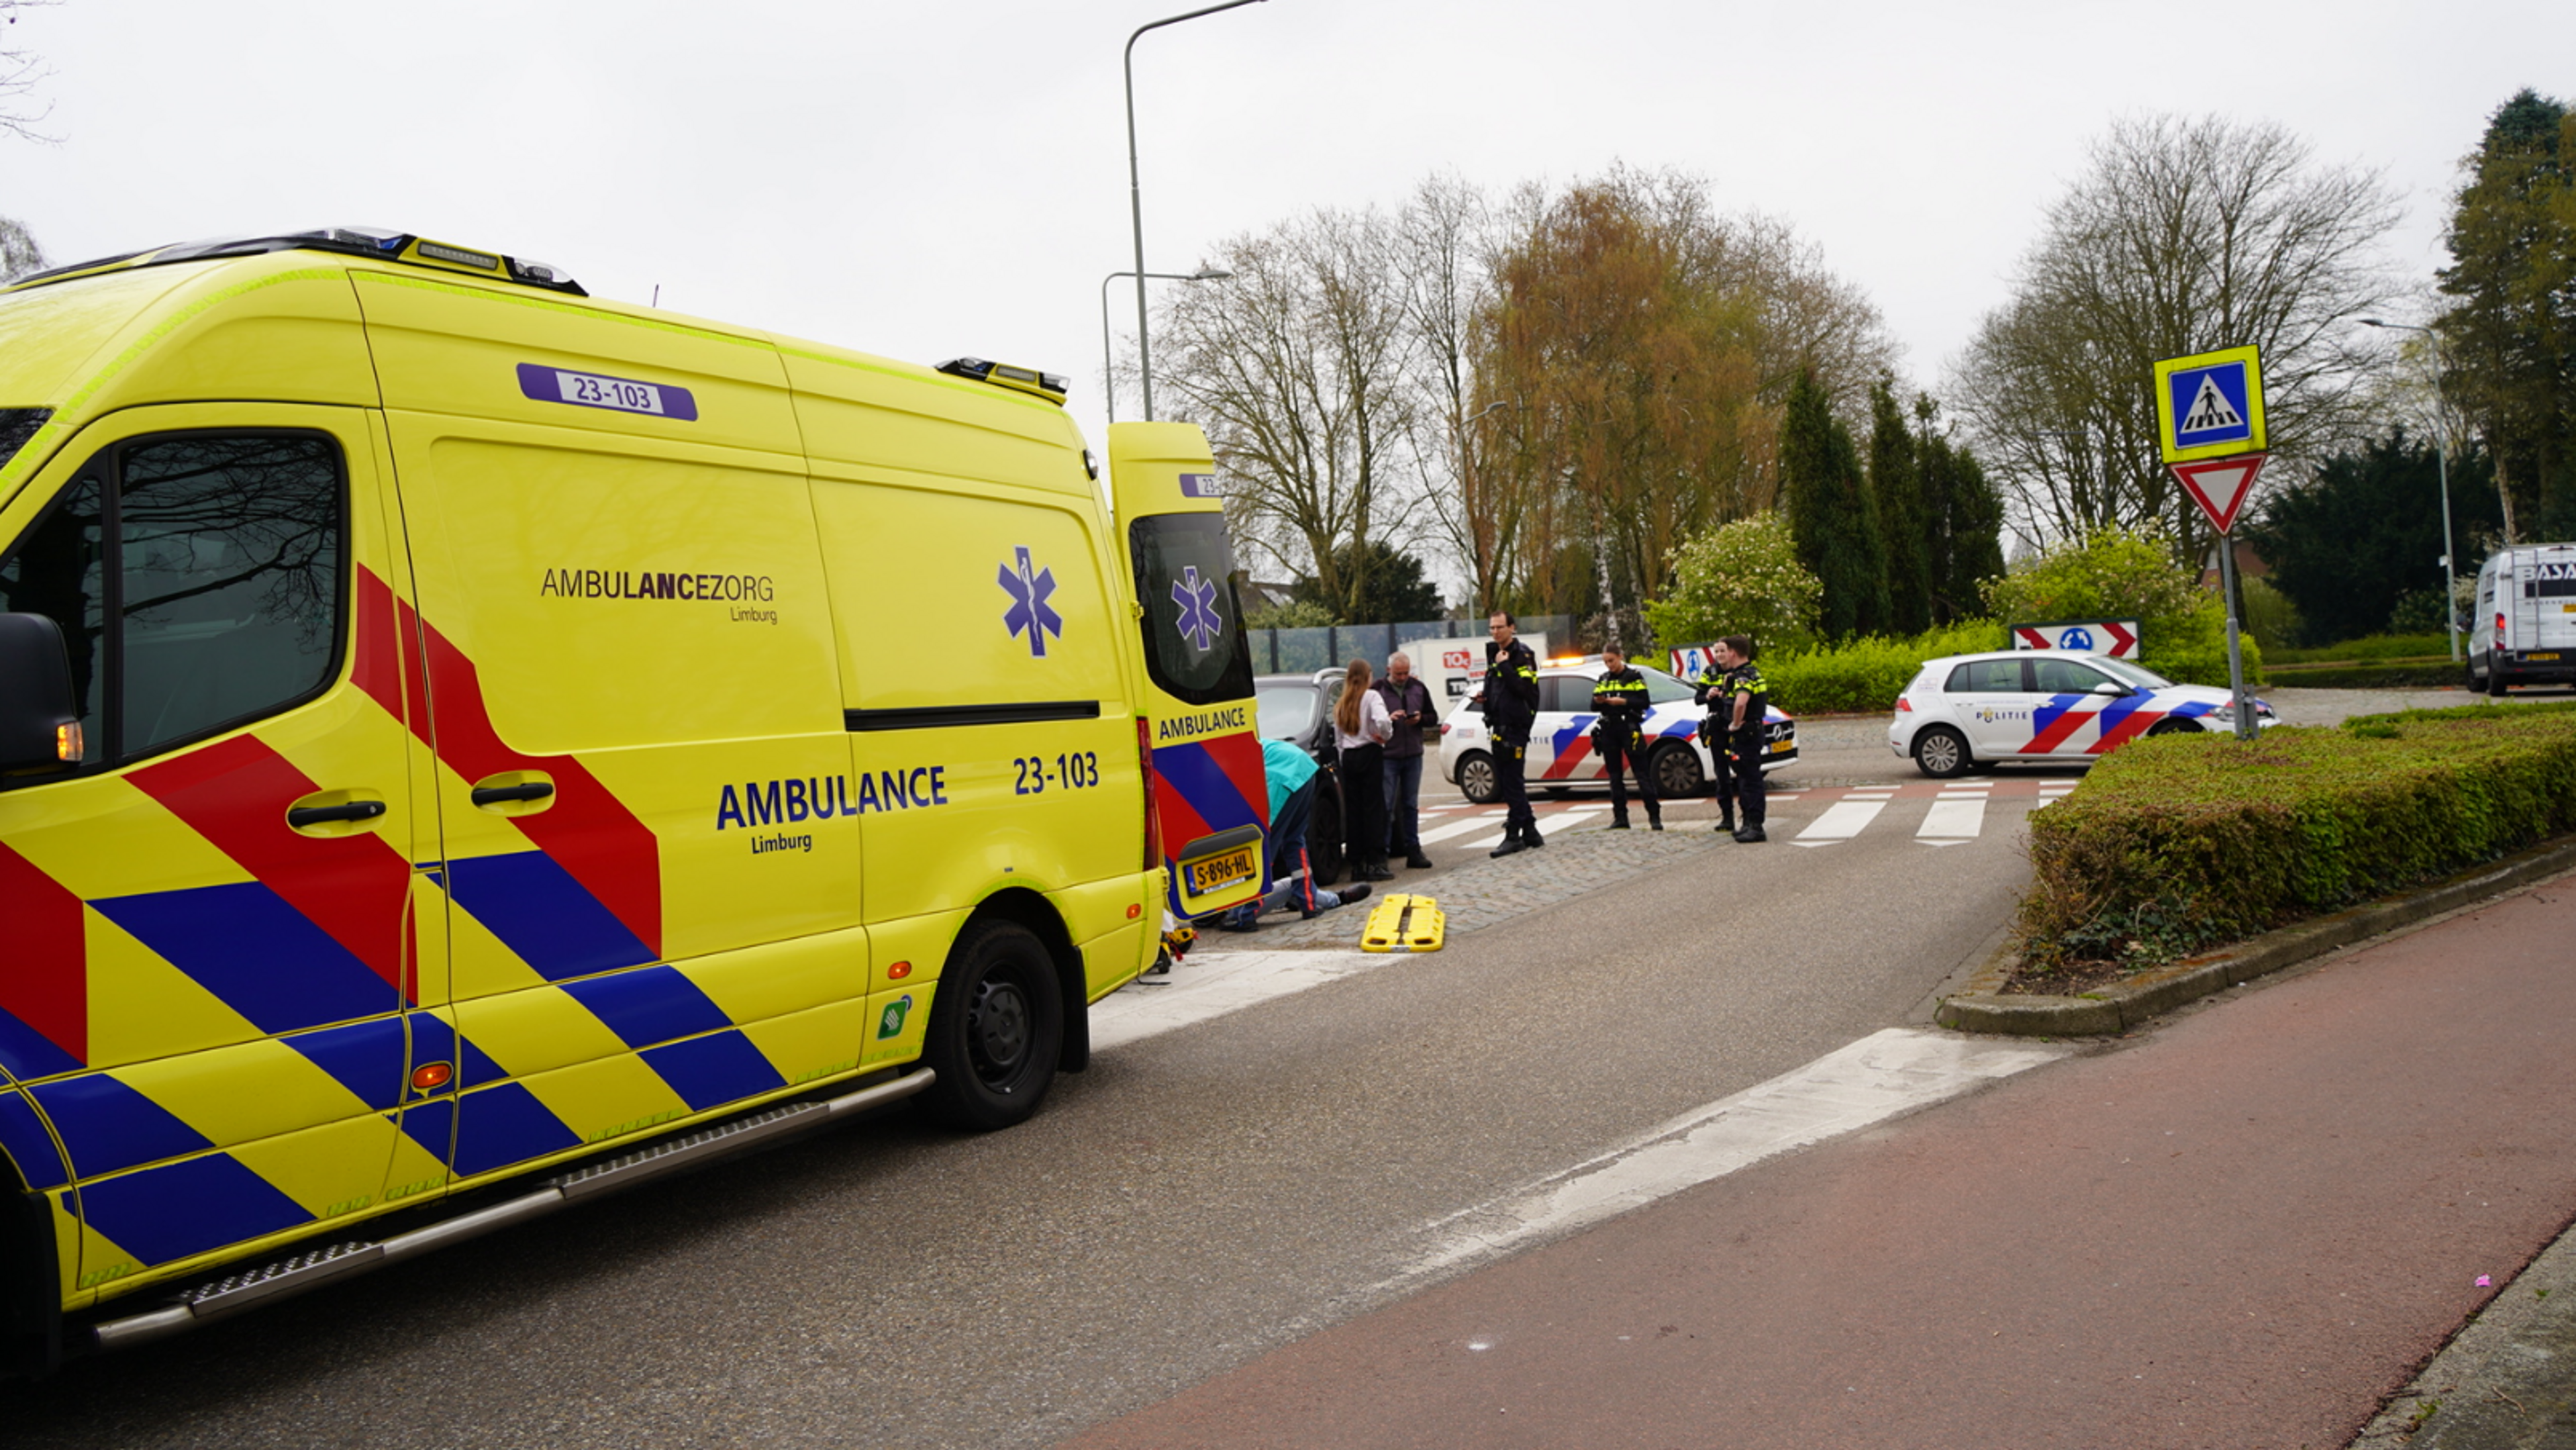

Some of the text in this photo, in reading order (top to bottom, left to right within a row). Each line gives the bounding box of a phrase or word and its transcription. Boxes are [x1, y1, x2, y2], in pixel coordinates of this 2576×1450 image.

[574, 377, 651, 409] 23-103
[541, 569, 773, 601] AMBULANCEZORG
[730, 606, 777, 625] Limburg
[1159, 707, 1245, 740] AMBULANCE
[1013, 751, 1098, 795] 23-103
[717, 766, 948, 830] AMBULANCE
[751, 833, 812, 855] Limburg
[1197, 854, 1251, 885] S-896-HL
